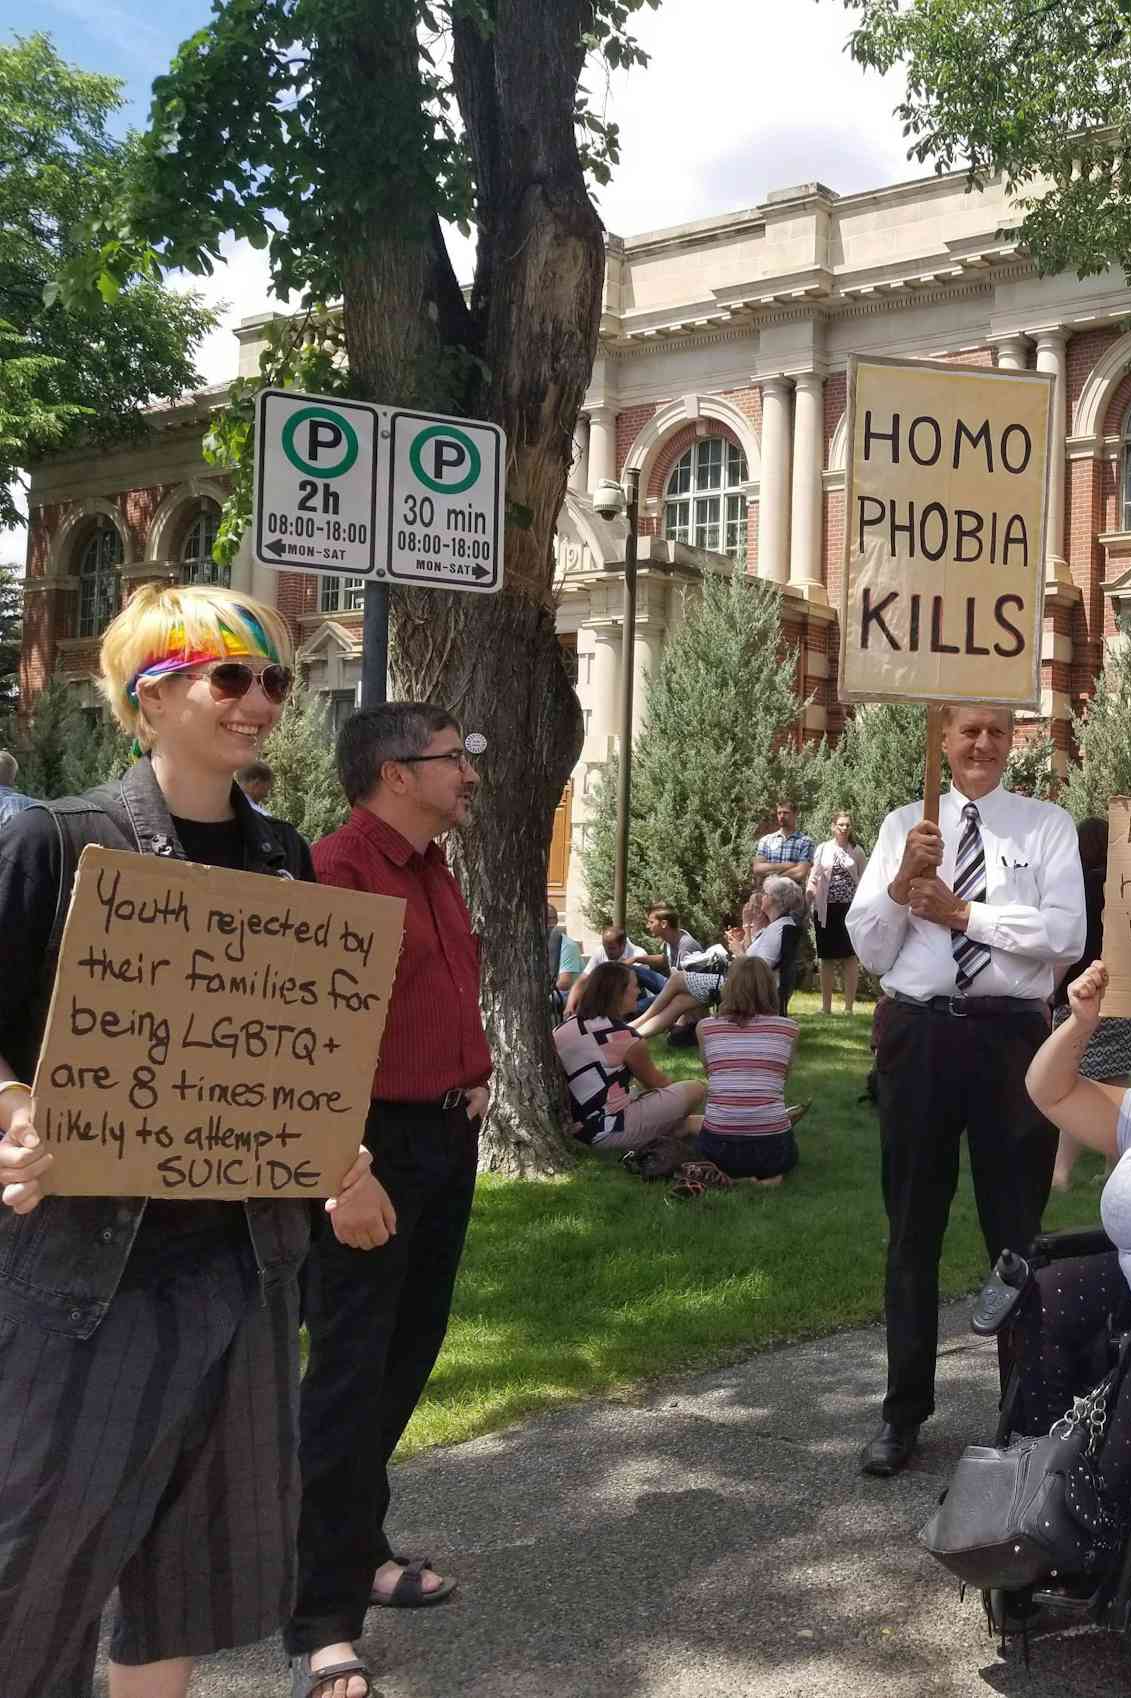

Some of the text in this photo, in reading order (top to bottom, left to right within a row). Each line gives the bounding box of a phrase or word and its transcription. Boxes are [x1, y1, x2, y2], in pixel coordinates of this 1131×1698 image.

[308, 419, 342, 461] P
[433, 439, 466, 480] P
[863, 410, 1032, 474] HOMO
[297, 479, 340, 515] 2h
[403, 494, 434, 528] 30
[268, 512, 367, 545] 08:00-18:00
[446, 503, 486, 535] min
[857, 495, 1028, 567] PHOBIA
[287, 543, 347, 560] MON-SAT
[398, 530, 490, 560] 08:00-18:00
[416, 559, 471, 576] MON-SAT
[860, 588, 1025, 657] KILLS
[96, 868, 374, 967] Youth rejected by
[78, 945, 381, 1011] their families for
[70, 995, 342, 1065] being LGBTQ+
[50, 1064, 352, 1113] are 8 times more
[45, 1107, 302, 1162] likely to attempt
